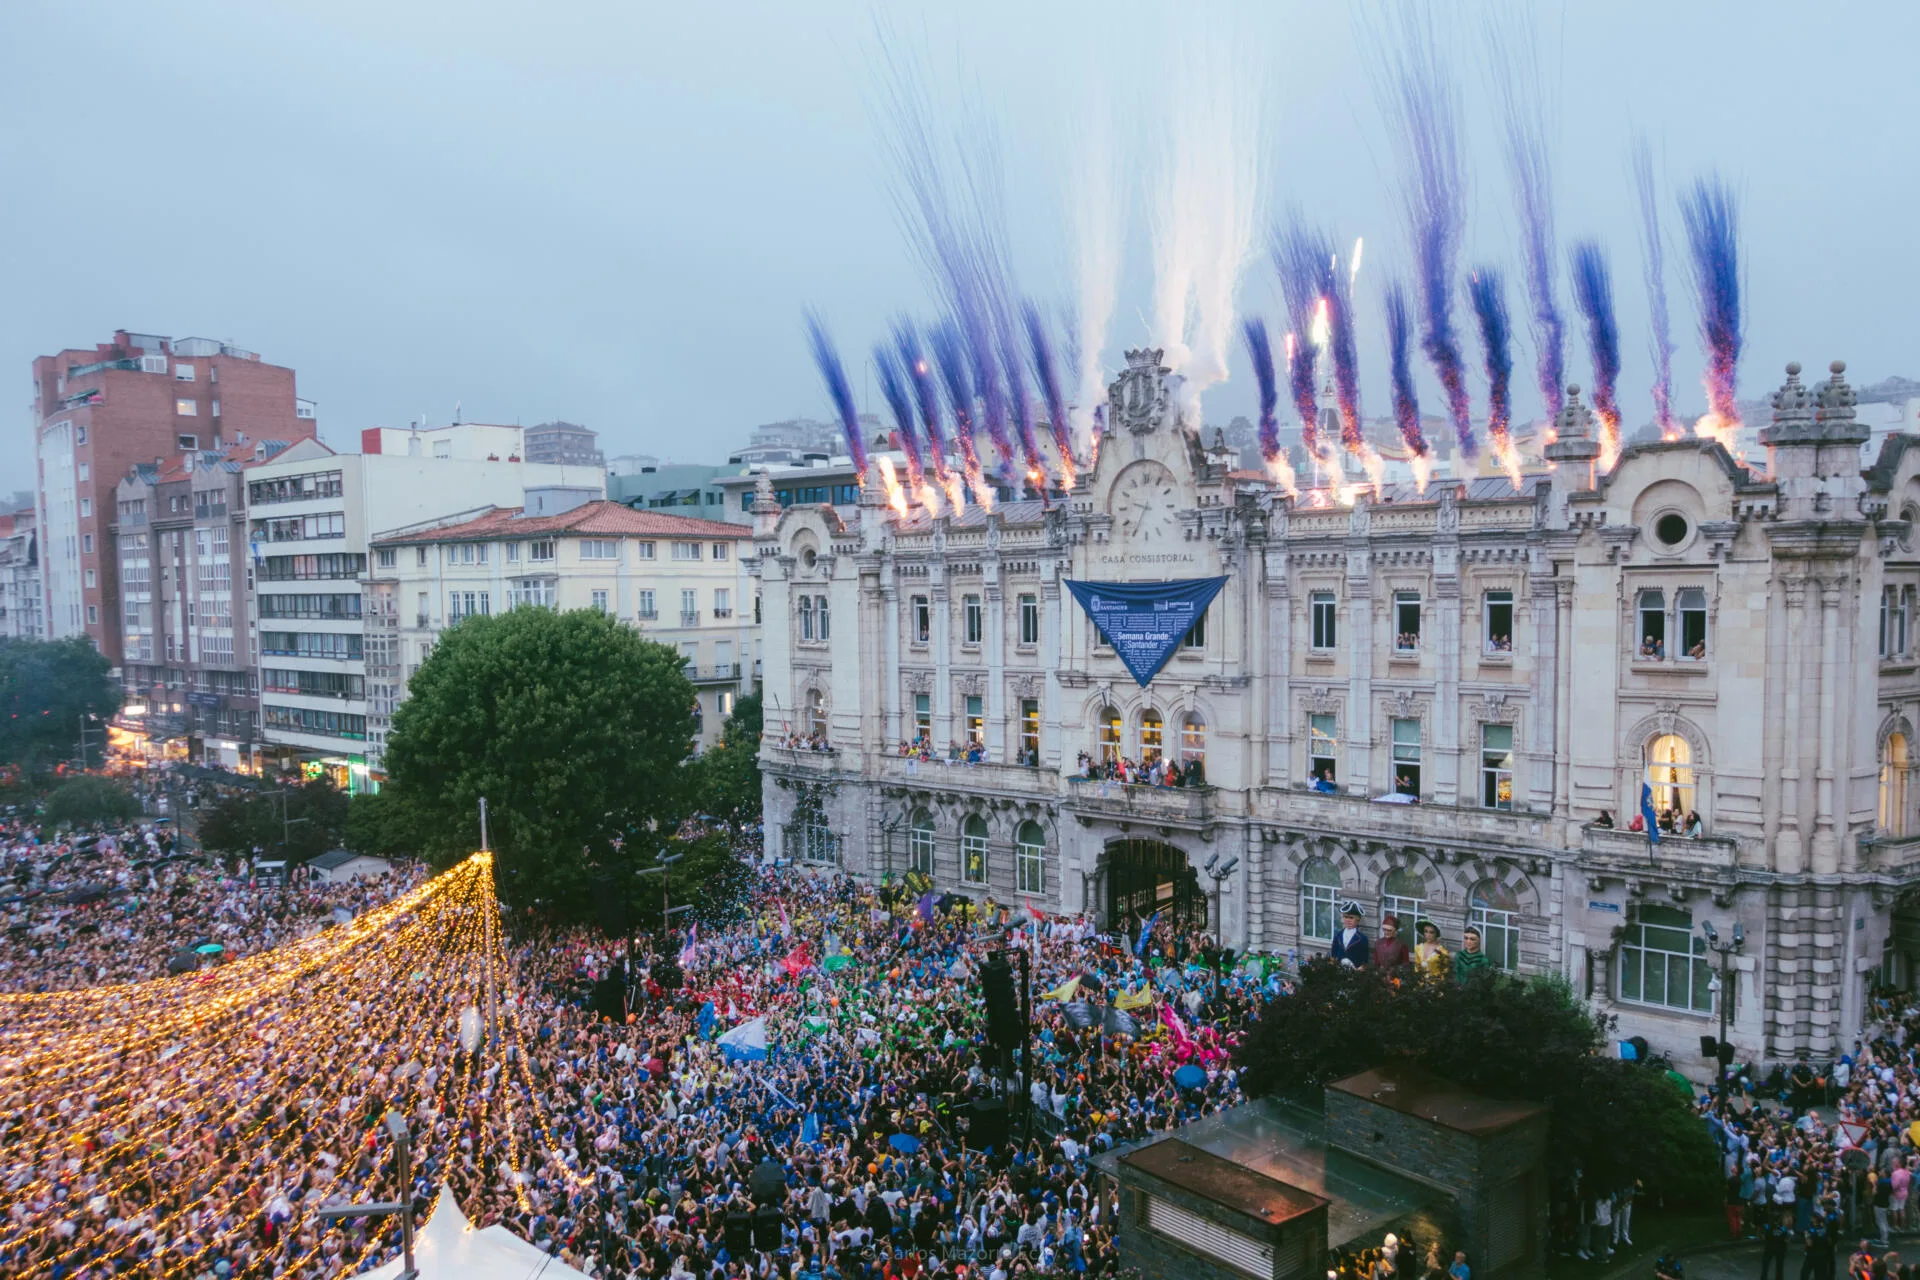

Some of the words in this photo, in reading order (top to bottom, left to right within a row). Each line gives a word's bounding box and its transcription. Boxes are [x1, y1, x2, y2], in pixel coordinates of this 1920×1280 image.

[1102, 555, 1126, 564] CASA
[1129, 553, 1195, 564] CONSISTORIAL
[1117, 632, 1144, 641] Semana
[1145, 632, 1169, 641] Grande
[1127, 640, 1159, 649] Santander
